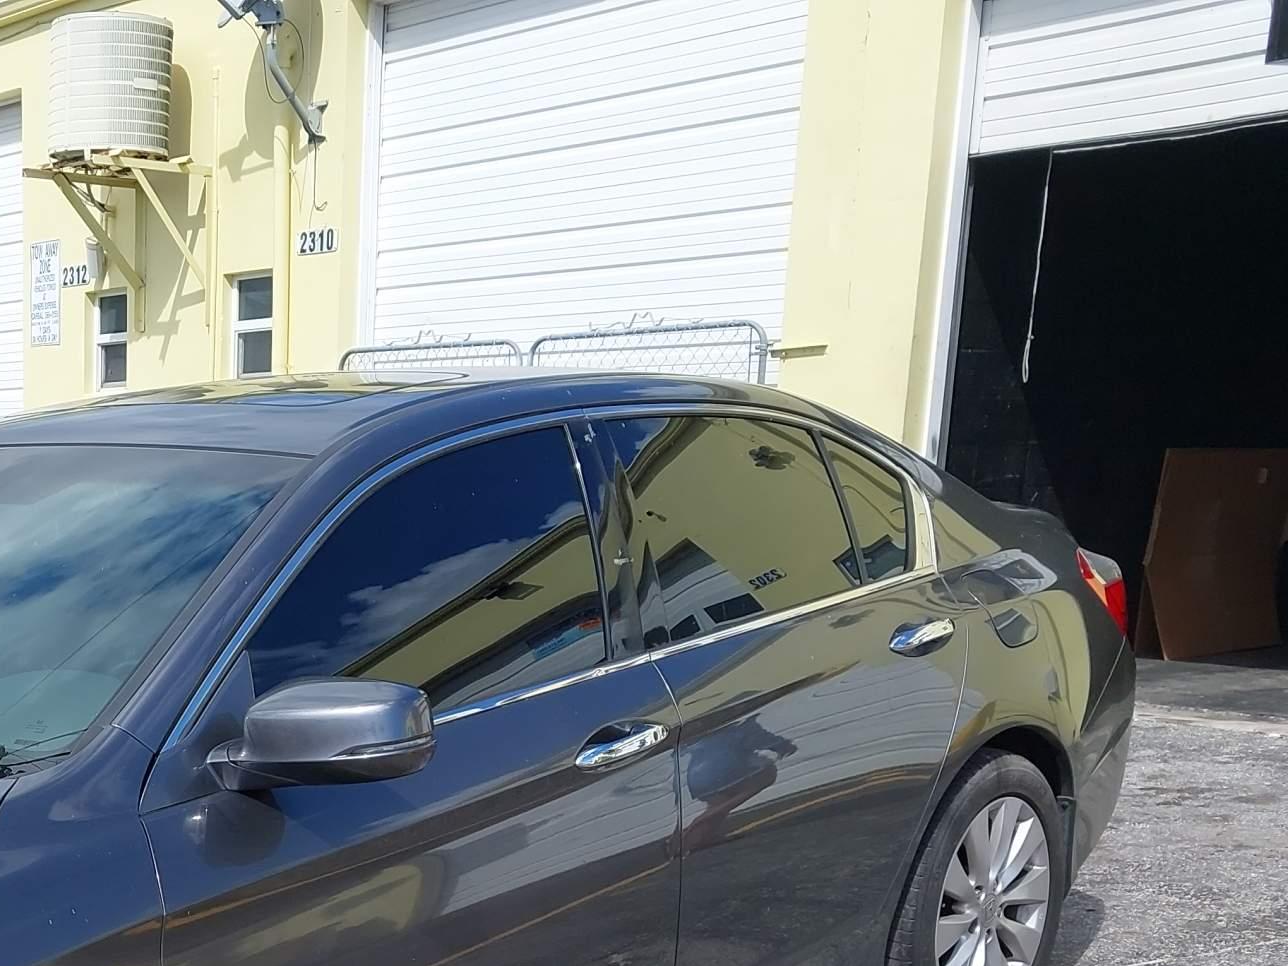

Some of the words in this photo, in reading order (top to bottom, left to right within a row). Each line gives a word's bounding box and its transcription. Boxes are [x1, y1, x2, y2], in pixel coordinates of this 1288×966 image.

[299, 228, 334, 253] 2310
[31, 244, 43, 260] TOW
[63, 264, 87, 286] 2312
